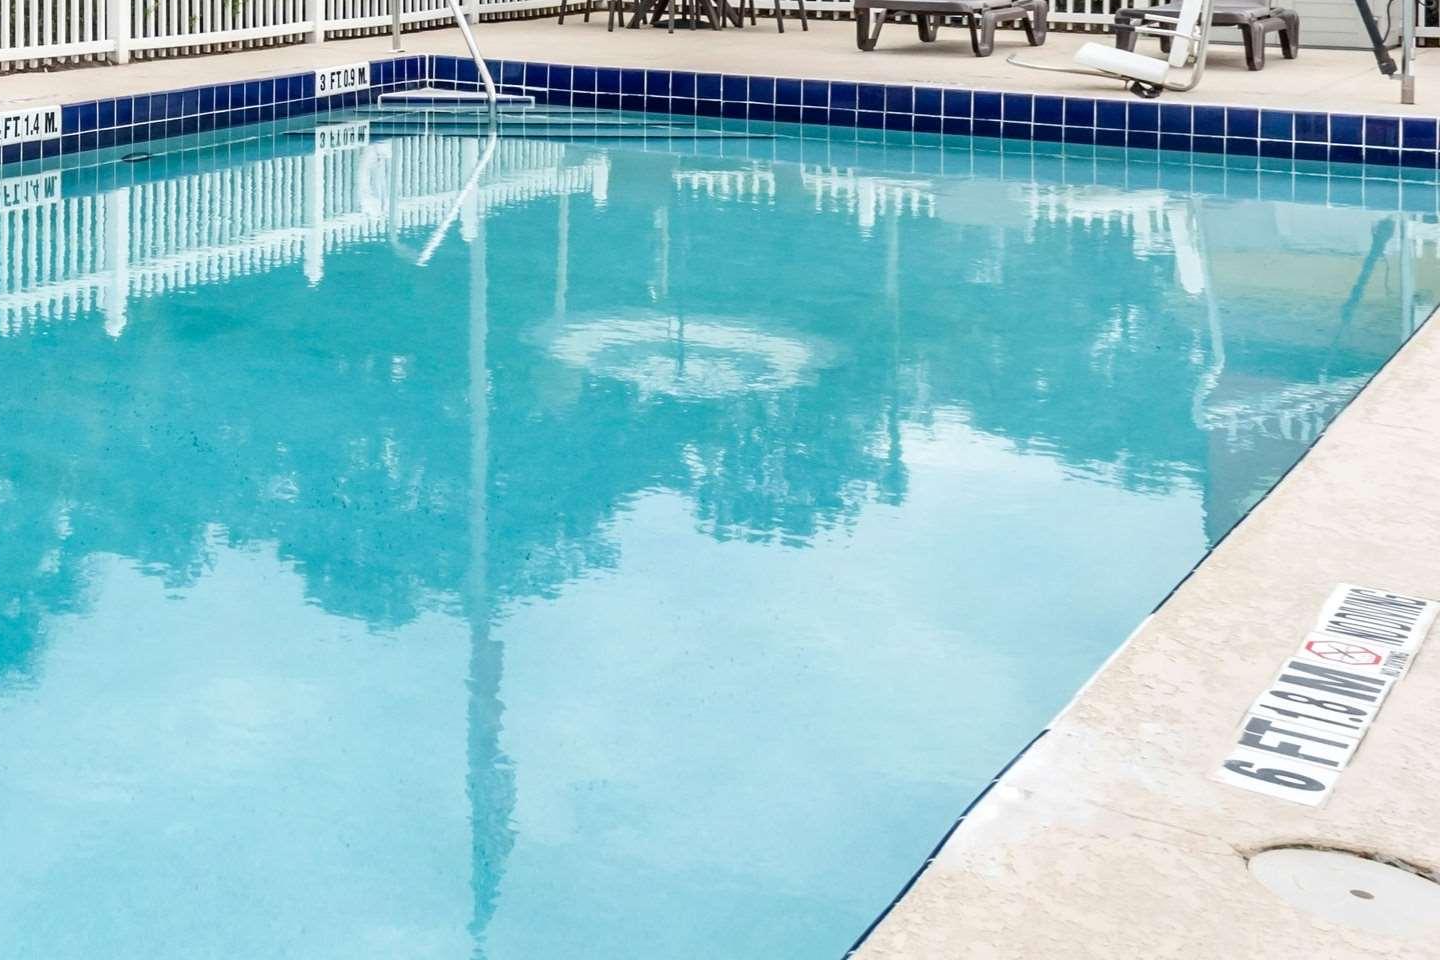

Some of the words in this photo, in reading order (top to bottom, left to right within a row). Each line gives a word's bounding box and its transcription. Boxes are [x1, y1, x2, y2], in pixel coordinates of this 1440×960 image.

[320, 74, 326, 91] 3
[4, 116, 20, 139] FT.
[24, 113, 39, 135] 1.4
[44, 112, 57, 133] M.
[1334, 589, 1427, 632] DIVING
[1325, 620, 1409, 646] NO
[1278, 660, 1387, 703] M
[1259, 690, 1368, 730] 1.8
[1237, 716, 1350, 768] FT
[1221, 759, 1326, 792] 6
